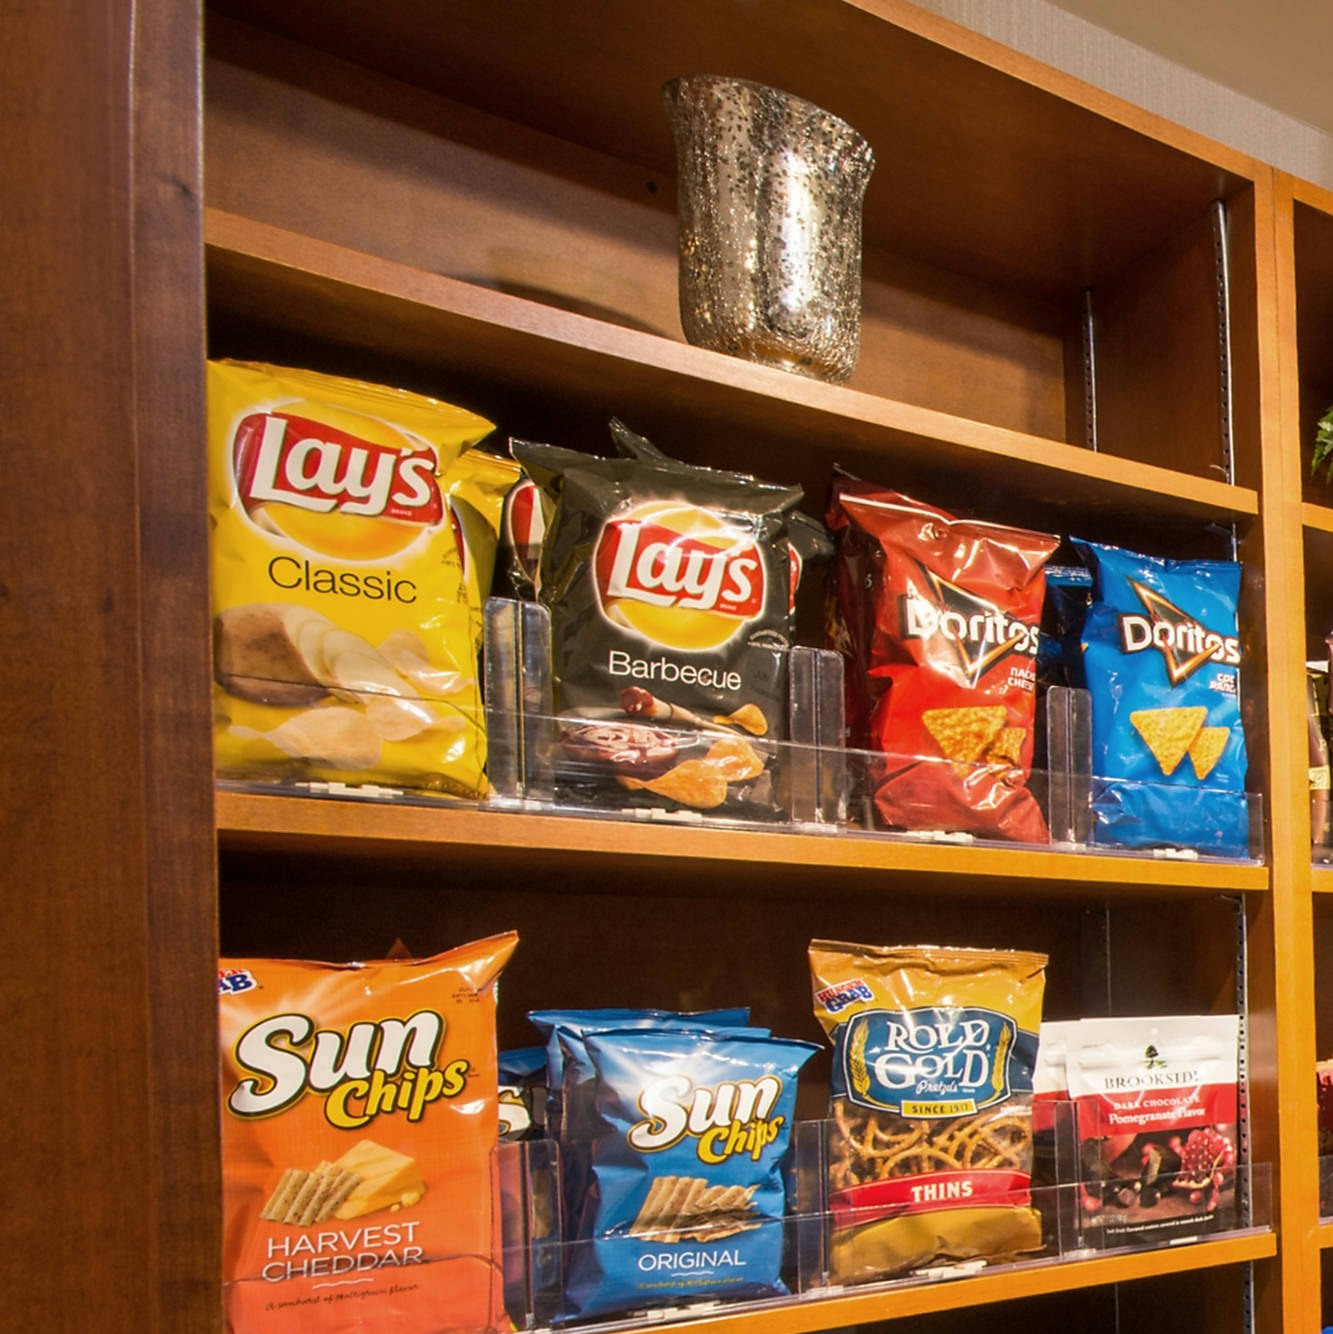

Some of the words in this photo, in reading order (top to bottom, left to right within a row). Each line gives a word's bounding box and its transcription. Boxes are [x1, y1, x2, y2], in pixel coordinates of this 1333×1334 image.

[250, 416, 437, 516] Lay's
[268, 556, 417, 604] Classic
[607, 522, 757, 611] Lay's
[906, 594, 1039, 656] Doritos
[1123, 615, 1241, 665] Doritos
[608, 650, 742, 691] Barbecue
[825, 985, 873, 1013] GRAB
[883, 1019, 991, 1054] ROLD
[229, 1010, 441, 1114] Sun
[874, 1049, 990, 1090] GOLD
[325, 1059, 469, 1127] Chips
[915, 1079, 958, 1095] Pretzels
[1142, 1095, 1201, 1109] CHOCOLATE
[630, 1076, 781, 1148] Sun
[911, 1105, 945, 1115] SINCE
[1108, 1109, 1175, 1126] Pomegranate
[1176, 1107, 1206, 1119] Flavor
[697, 1116, 784, 1164] Chips
[910, 1179, 974, 1204] THINS
[267, 1221, 421, 1260] HARVEST
[637, 1249, 747, 1273] ORIGINAL
[261, 1246, 424, 1283] CHEDDAR
